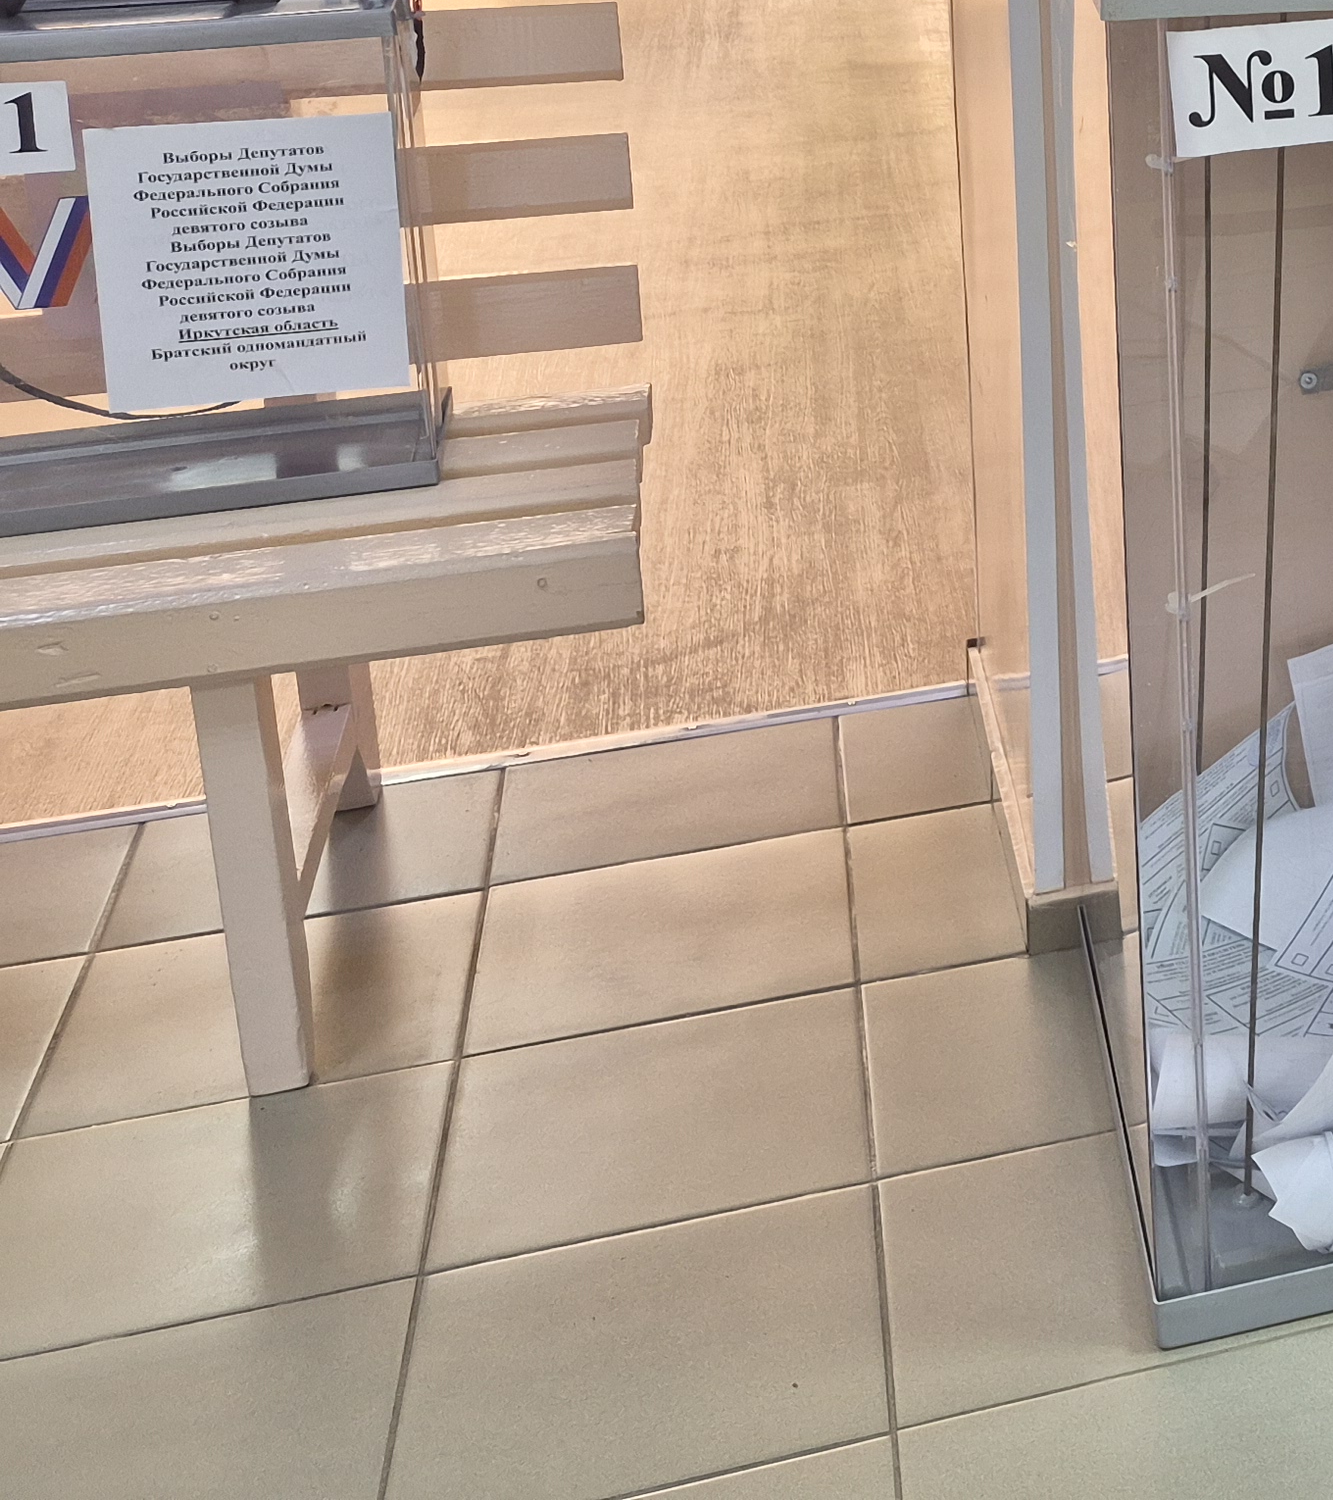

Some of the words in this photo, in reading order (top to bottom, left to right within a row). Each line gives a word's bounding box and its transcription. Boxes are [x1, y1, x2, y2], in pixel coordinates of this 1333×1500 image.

[4, 92, 48, 154] 1
[163, 151, 232, 165] Выборы
[237, 144, 325, 162] Депутатов
[138, 164, 280, 185] Государственной
[284, 161, 333, 178] Думы
[133, 184, 253, 203] Федерального
[258, 179, 340, 196] Собрания
[150, 201, 247, 219] Российской
[252, 196, 344, 214] Федерации
[171, 220, 245, 236] девятого
[250, 217, 308, 230] созыва
[170, 238, 240, 254] Выборы
[245, 232, 331, 249] Депутатов
[146, 251, 287, 273] Государственной
[291, 248, 340, 266] Думы
[141, 271, 261, 291] Федерального
[265, 265, 347, 283] Собрания
[158, 288, 255, 307] Российской
[259, 283, 351, 301] Федерации
[180, 307, 253, 324] девятого
[257, 303, 315, 318] созыва
[178, 324, 270, 341] Иркутская
[274, 318, 339, 334] область
[151, 342, 232, 362] Братский
[236, 330, 367, 354] одномандатный
[229, 359, 277, 373] округ
